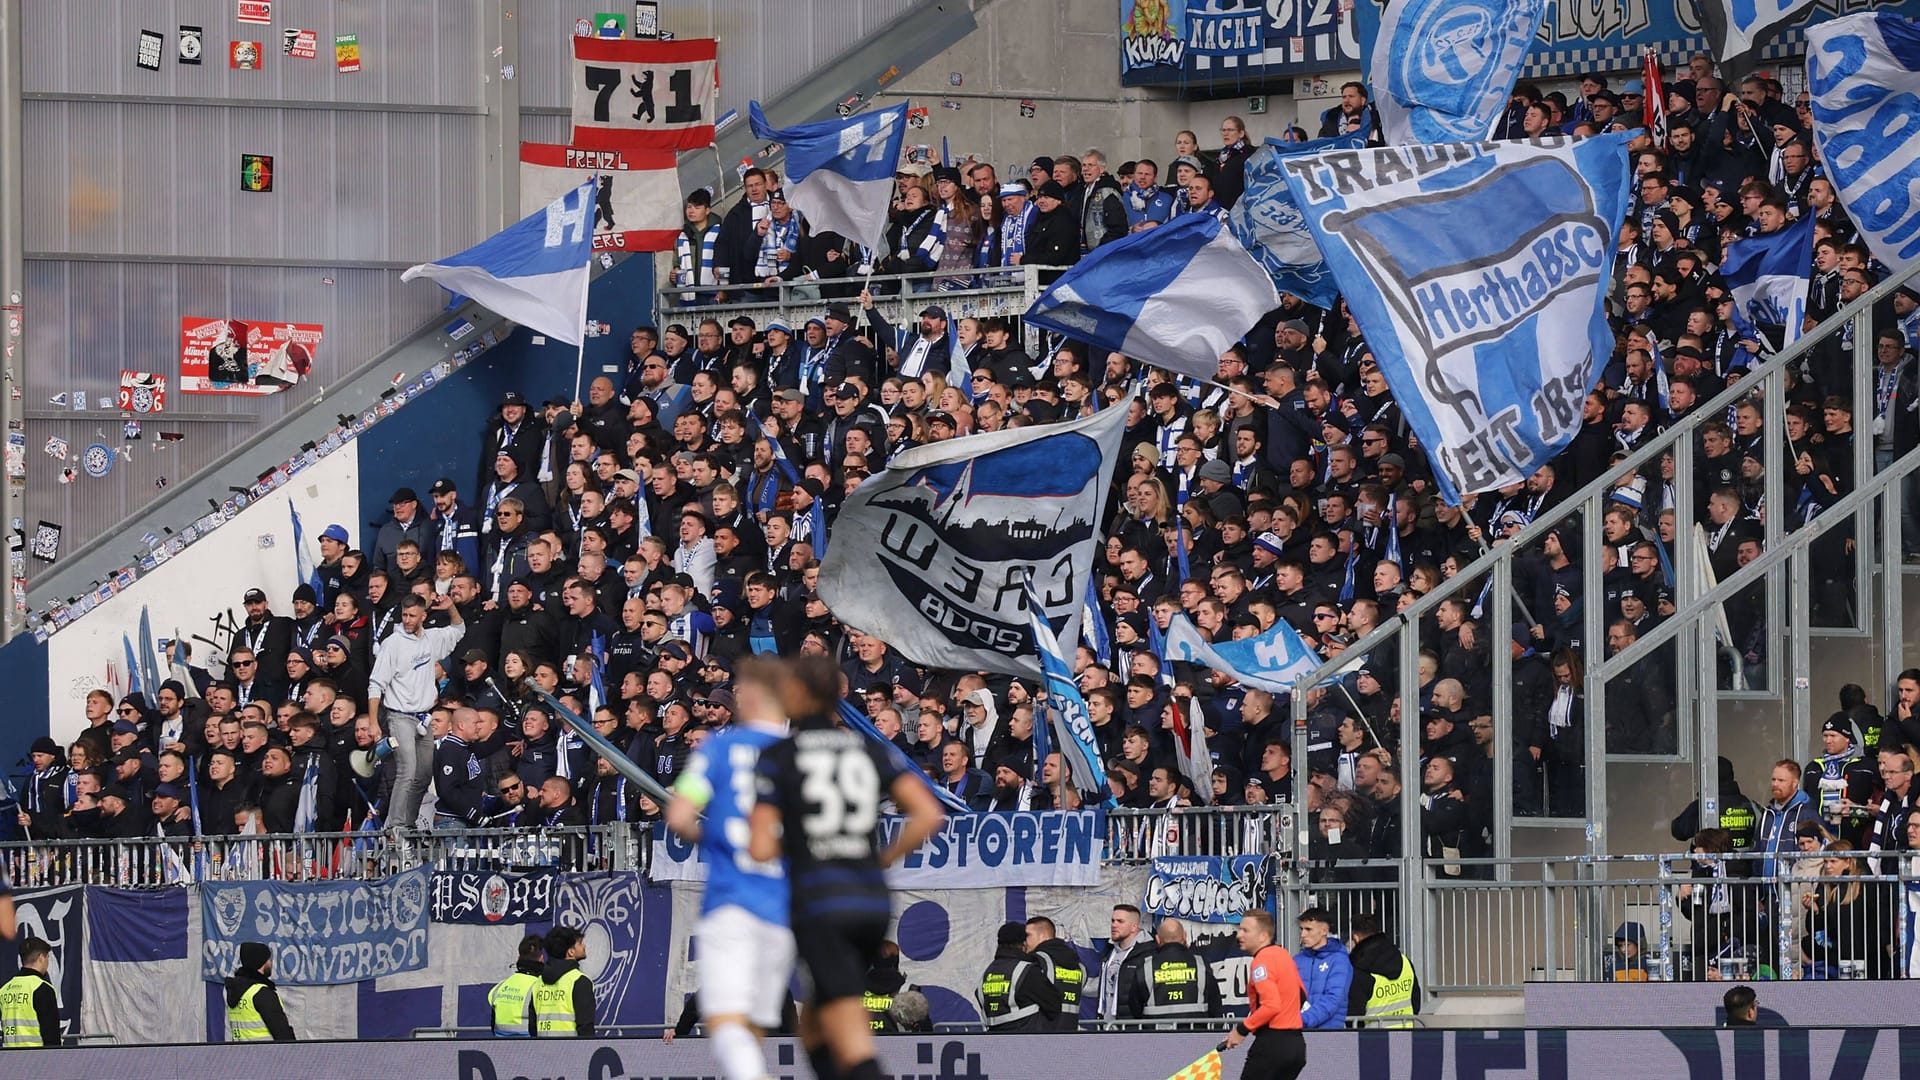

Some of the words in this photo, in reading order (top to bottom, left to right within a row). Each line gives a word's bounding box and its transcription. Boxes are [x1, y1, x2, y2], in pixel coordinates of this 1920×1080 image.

[1190, 16, 1262, 50] NACHT
[139, 53, 159, 67] 1996
[585, 66, 621, 122] 7
[665, 69, 702, 121] 1
[566, 150, 628, 170] PRENZ'L
[543, 185, 594, 249] H
[590, 233, 625, 249] ERG
[1254, 631, 1289, 668] H
[797, 749, 880, 836] 39
[1720, 816, 1754, 827] SECURITY
[511, 874, 554, 918] 99
[254, 885, 392, 938] SEKTION
[203, 928, 425, 982] STAIONVERBOT
[1055, 966, 1082, 982] SECURITY
[1154, 968, 1196, 983] SECURITY
[983, 981, 1010, 994] SECURITY
[1168, 991, 1184, 1000] 751
[1375, 978, 1413, 999] ORDNER
[863, 997, 893, 1009] ECURITY
[540, 1021, 551, 1031] 136
[869, 1021, 884, 1029] 734
